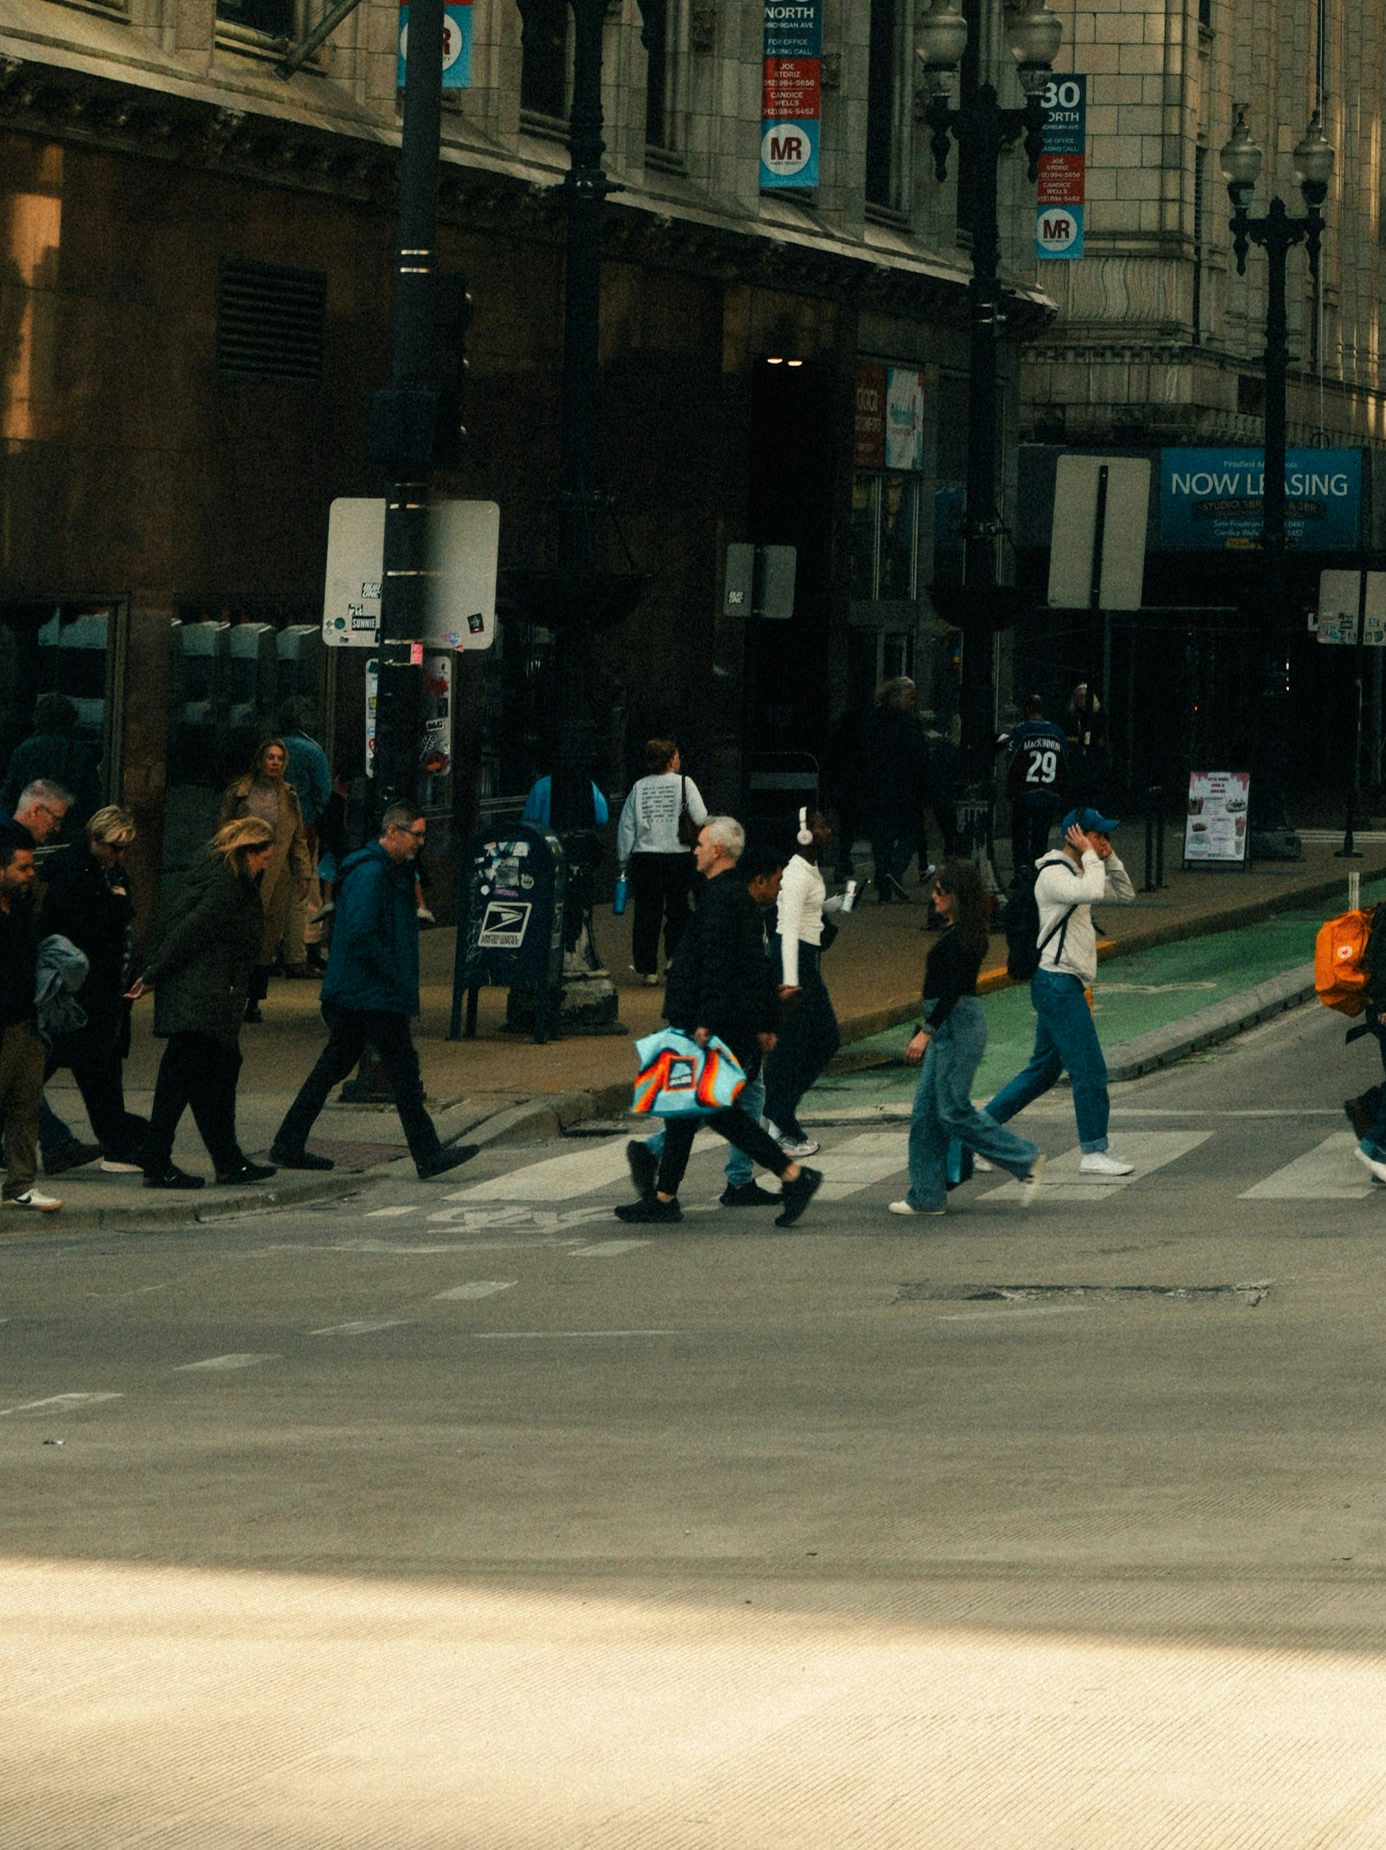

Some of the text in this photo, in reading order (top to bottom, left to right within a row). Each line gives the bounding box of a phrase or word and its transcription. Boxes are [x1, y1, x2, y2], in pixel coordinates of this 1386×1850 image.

[765, 7, 815, 19] NORTH
[770, 91, 804, 99] CANDICE
[775, 99, 800, 107] WELLS
[1041, 82, 1080, 108] 30
[1048, 112, 1079, 122] ORTH
[771, 137, 802, 160] MR
[1044, 220, 1070, 239] MR
[1171, 473, 1239, 496] NOW
[1026, 750, 1057, 784] 29
